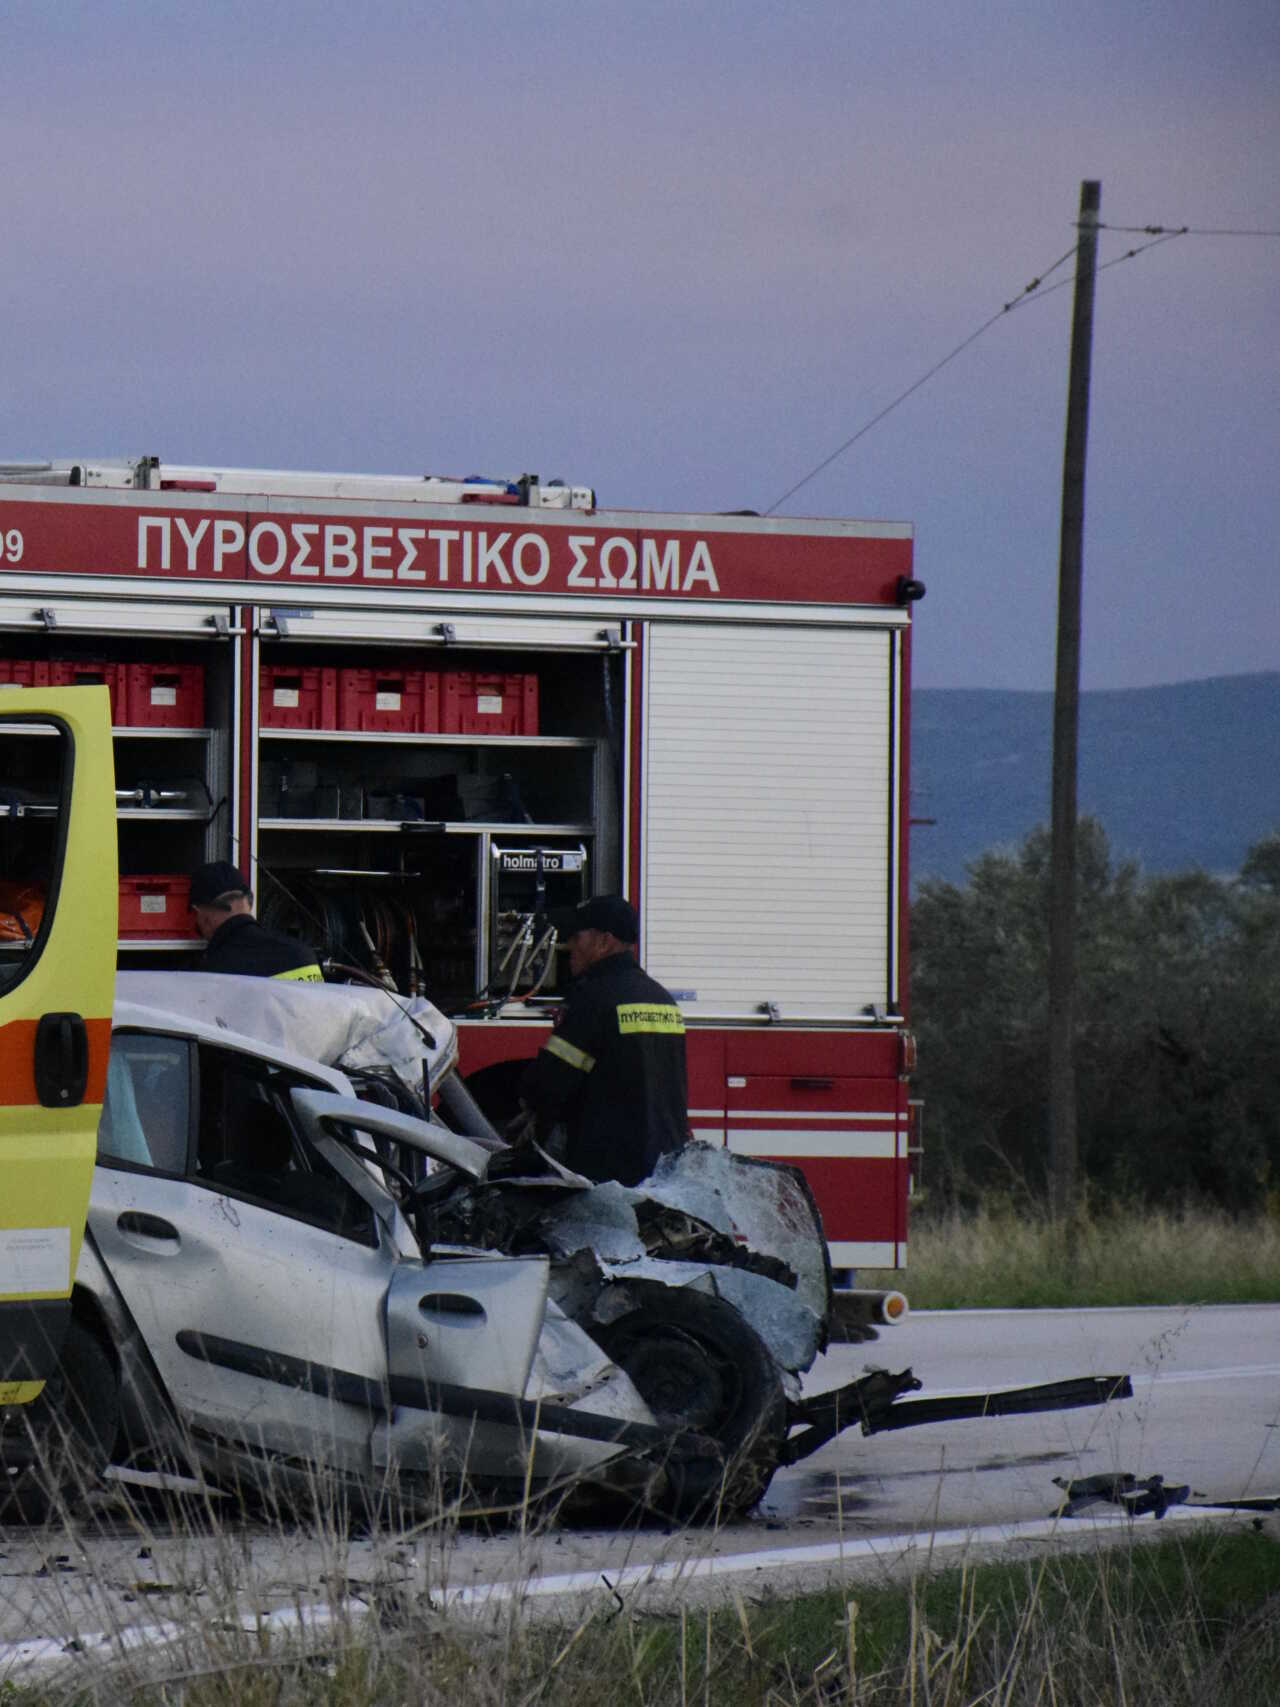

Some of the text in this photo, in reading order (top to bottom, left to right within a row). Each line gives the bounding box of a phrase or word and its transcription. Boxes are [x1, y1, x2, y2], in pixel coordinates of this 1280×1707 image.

[136, 515, 720, 593] ΠΥΡΟΣΒΕΣΤΙΚΟ ΣΩΜΑ
[503, 855, 560, 869] holmtro
